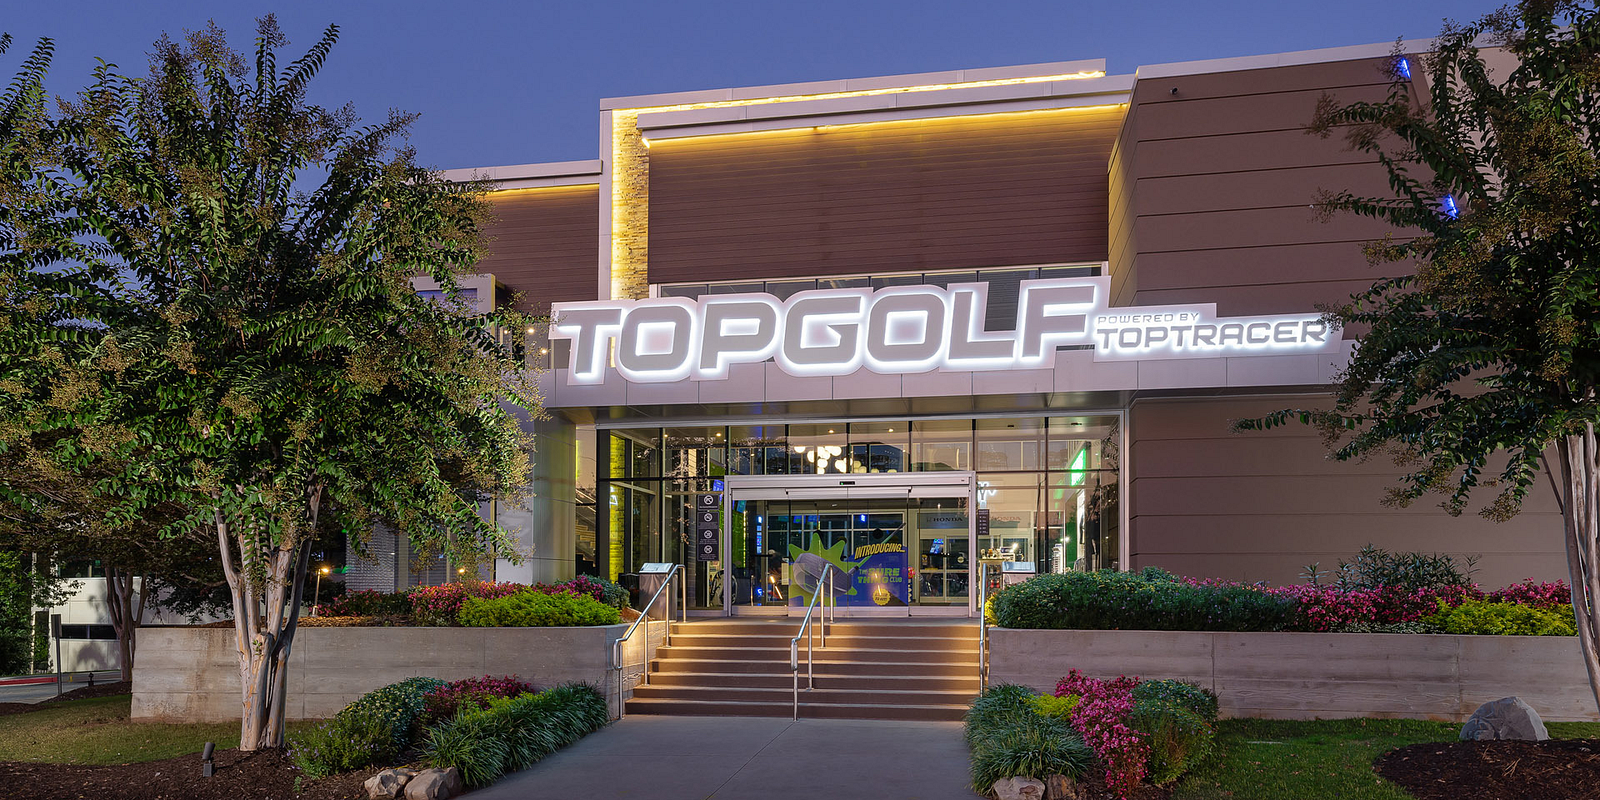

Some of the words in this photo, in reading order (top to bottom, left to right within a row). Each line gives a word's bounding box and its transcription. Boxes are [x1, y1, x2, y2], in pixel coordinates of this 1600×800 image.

[1098, 313, 1174, 325] POWERED
[1179, 313, 1200, 321] BY
[557, 285, 1095, 374] TOPGOLF
[1097, 321, 1326, 349] TOPTRACER
[868, 568, 900, 576] SURE
